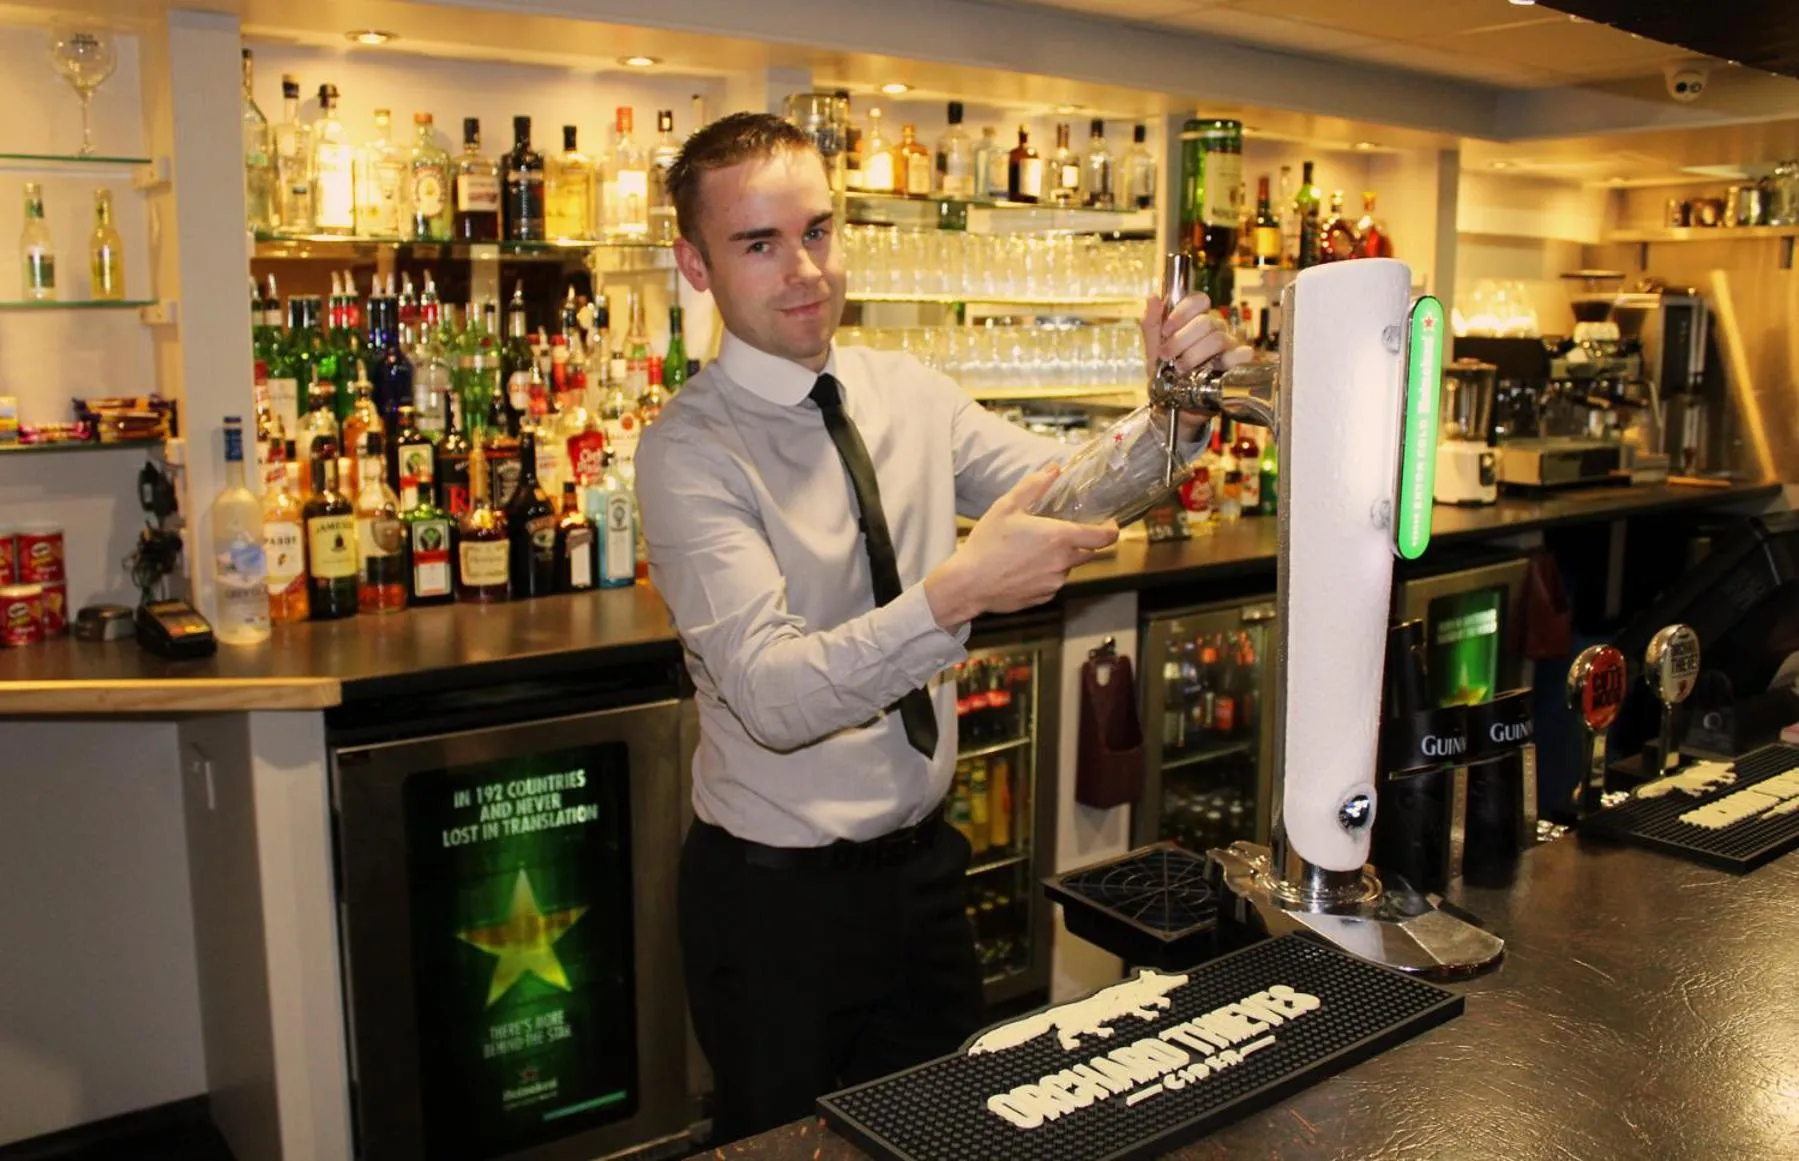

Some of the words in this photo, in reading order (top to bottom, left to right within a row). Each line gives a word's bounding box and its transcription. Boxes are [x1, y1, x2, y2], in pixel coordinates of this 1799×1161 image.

[453, 789, 471, 808] IN
[476, 784, 503, 805] 192
[507, 769, 586, 798] COUNTRIES
[480, 801, 512, 822] AND
[516, 792, 561, 815] NEVER
[442, 824, 479, 848] LOST
[482, 821, 499, 841] IN
[502, 803, 598, 836] TRANSLATION
[987, 1037, 1189, 1129] ORCHARD
[1158, 985, 1320, 1057] THIEVES
